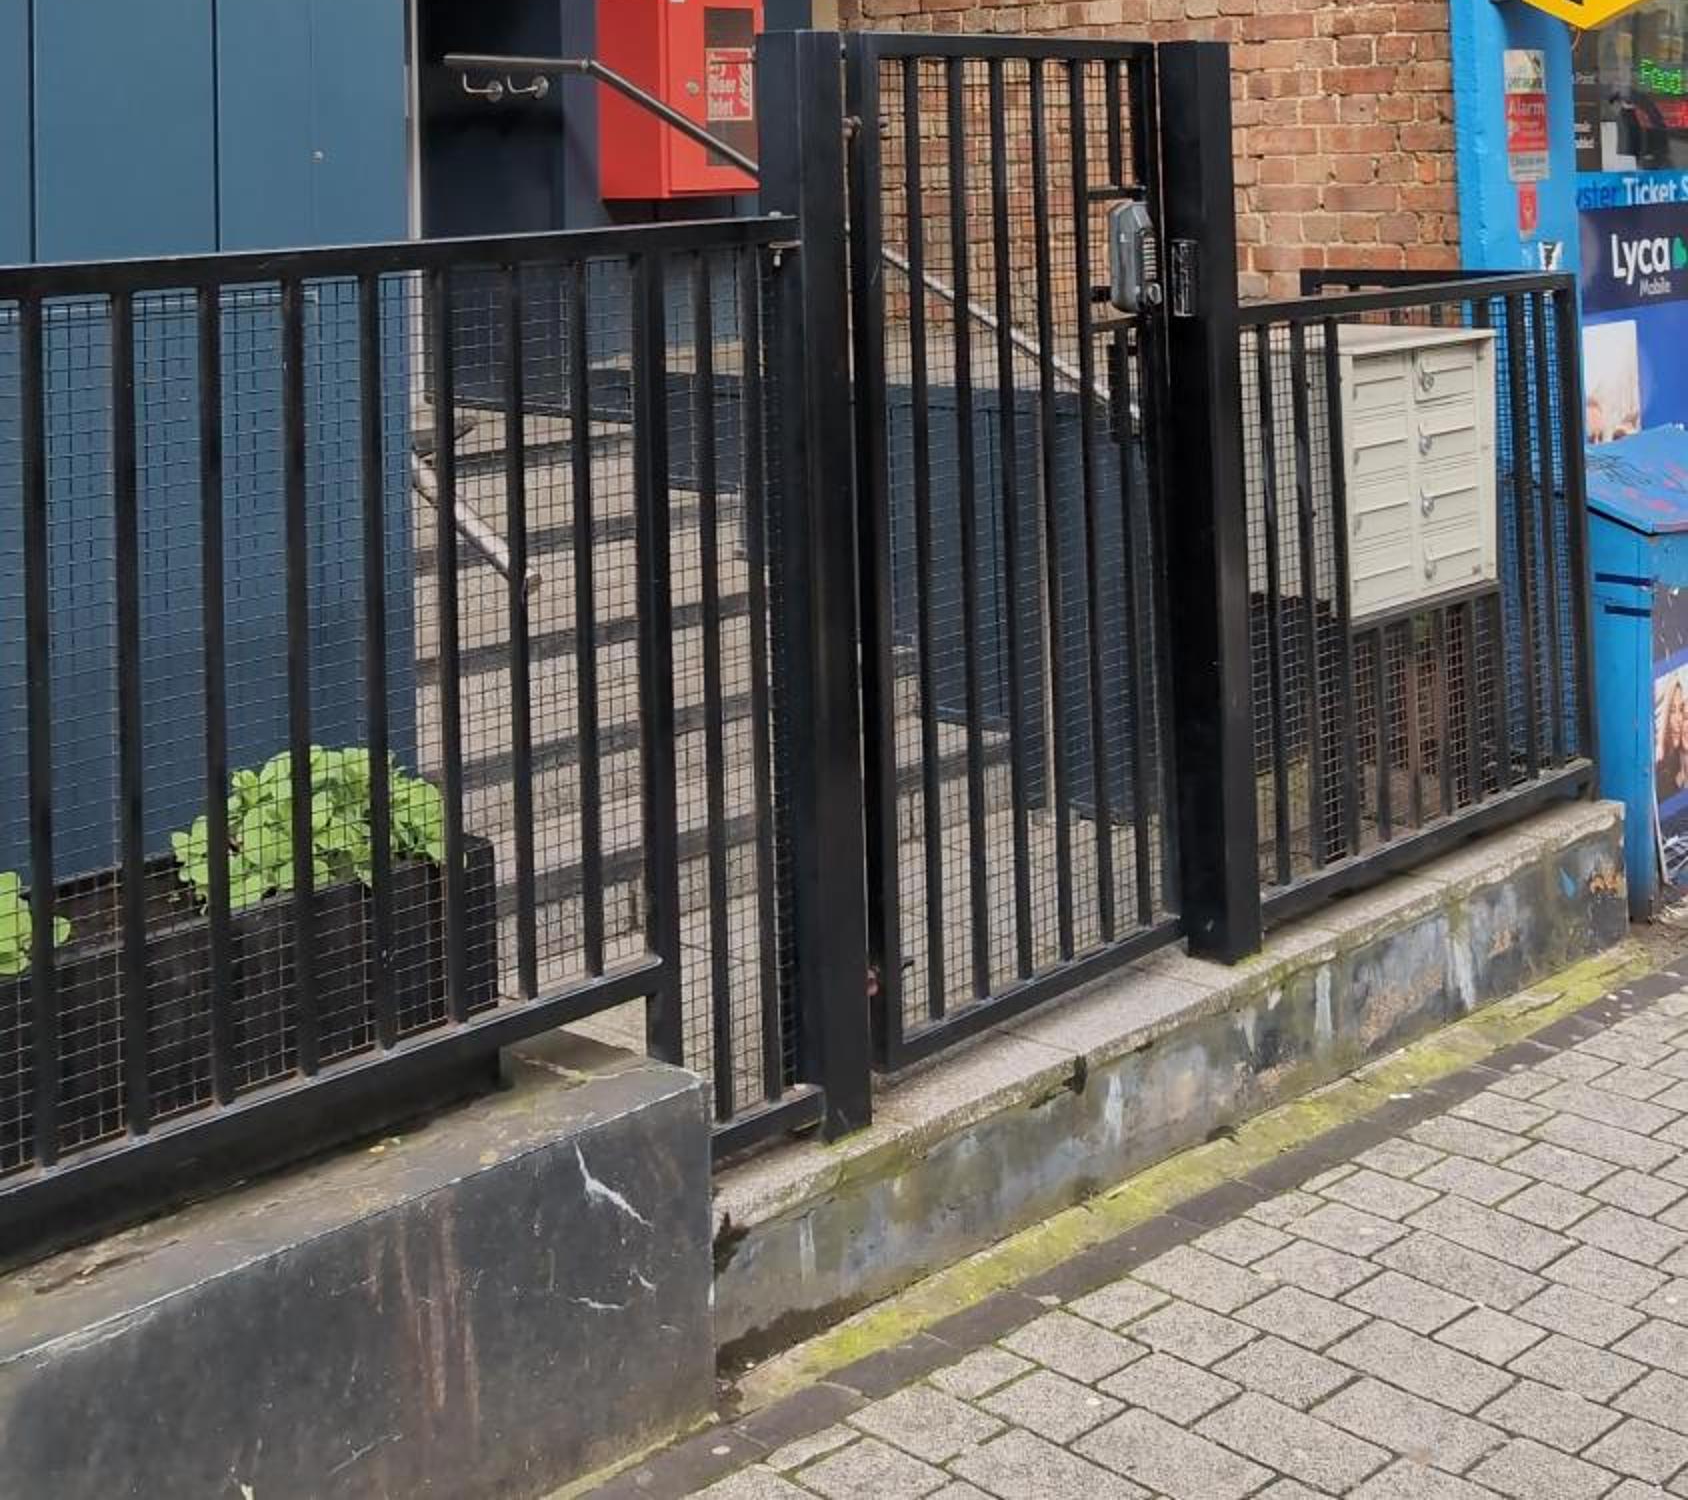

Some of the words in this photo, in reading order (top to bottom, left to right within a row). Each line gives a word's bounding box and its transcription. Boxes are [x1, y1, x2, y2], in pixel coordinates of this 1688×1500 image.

[1508, 99, 1545, 117] Alarm
[1622, 176, 1676, 206] Ticket
[1611, 233, 1670, 285] Lyca
[1639, 276, 1672, 297] Mobile
